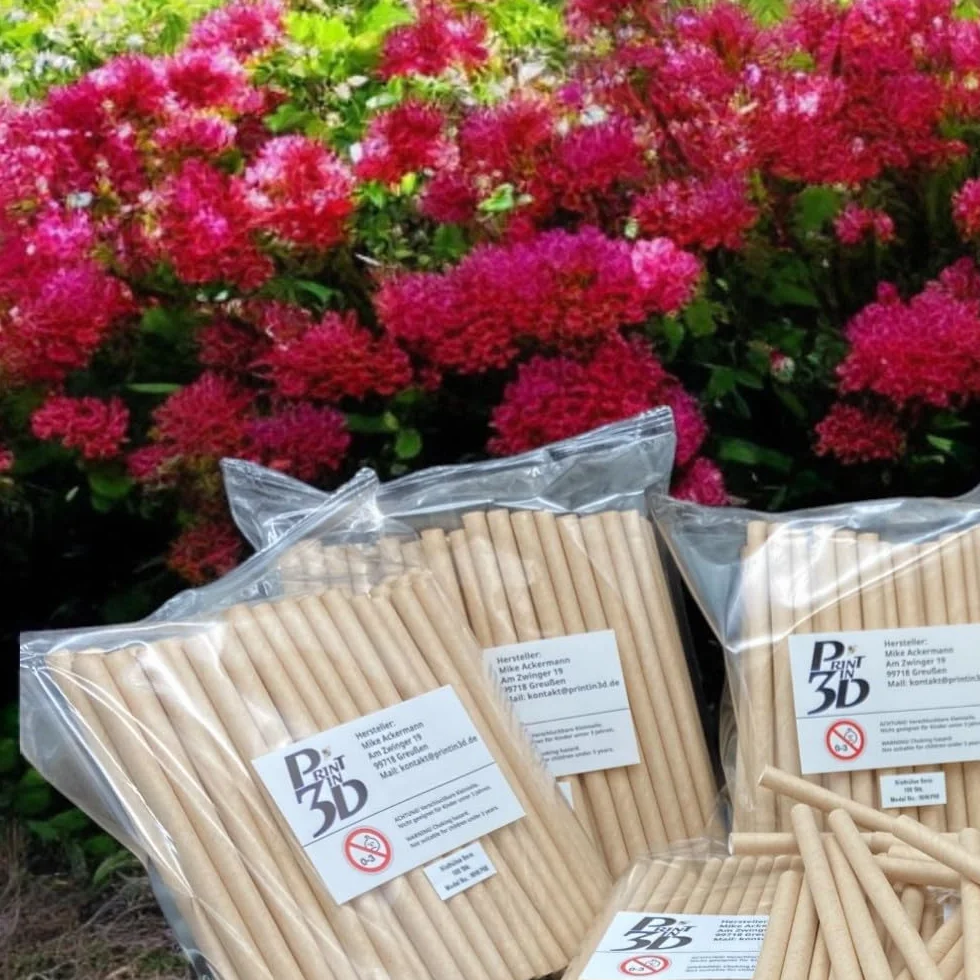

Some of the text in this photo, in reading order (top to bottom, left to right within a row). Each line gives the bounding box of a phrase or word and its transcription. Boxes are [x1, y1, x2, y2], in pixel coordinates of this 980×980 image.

[883, 638, 927, 647] Hersteller:
[906, 646, 953, 656] Ackermann
[498, 656, 570, 673] Mike Ackermann
[901, 657, 934, 668] Zwinger
[500, 675, 515, 684] Am
[516, 669, 551, 682] Zwinger
[886, 666, 947, 677] 99718 Greußen
[509, 678, 619, 702] ail: kontakt@printin3d.de
[528, 677, 566, 689] Greußen
[887, 679, 906, 687] Mail:
[354, 718, 396, 741] Hersteller:
[360, 720, 424, 750] Mike Ackermann
[367, 733, 423, 760] Am Zwinger 19
[372, 742, 429, 770] 99718 Greußen
[379, 734, 478, 780] Mail: kontakt@printin3d.de
